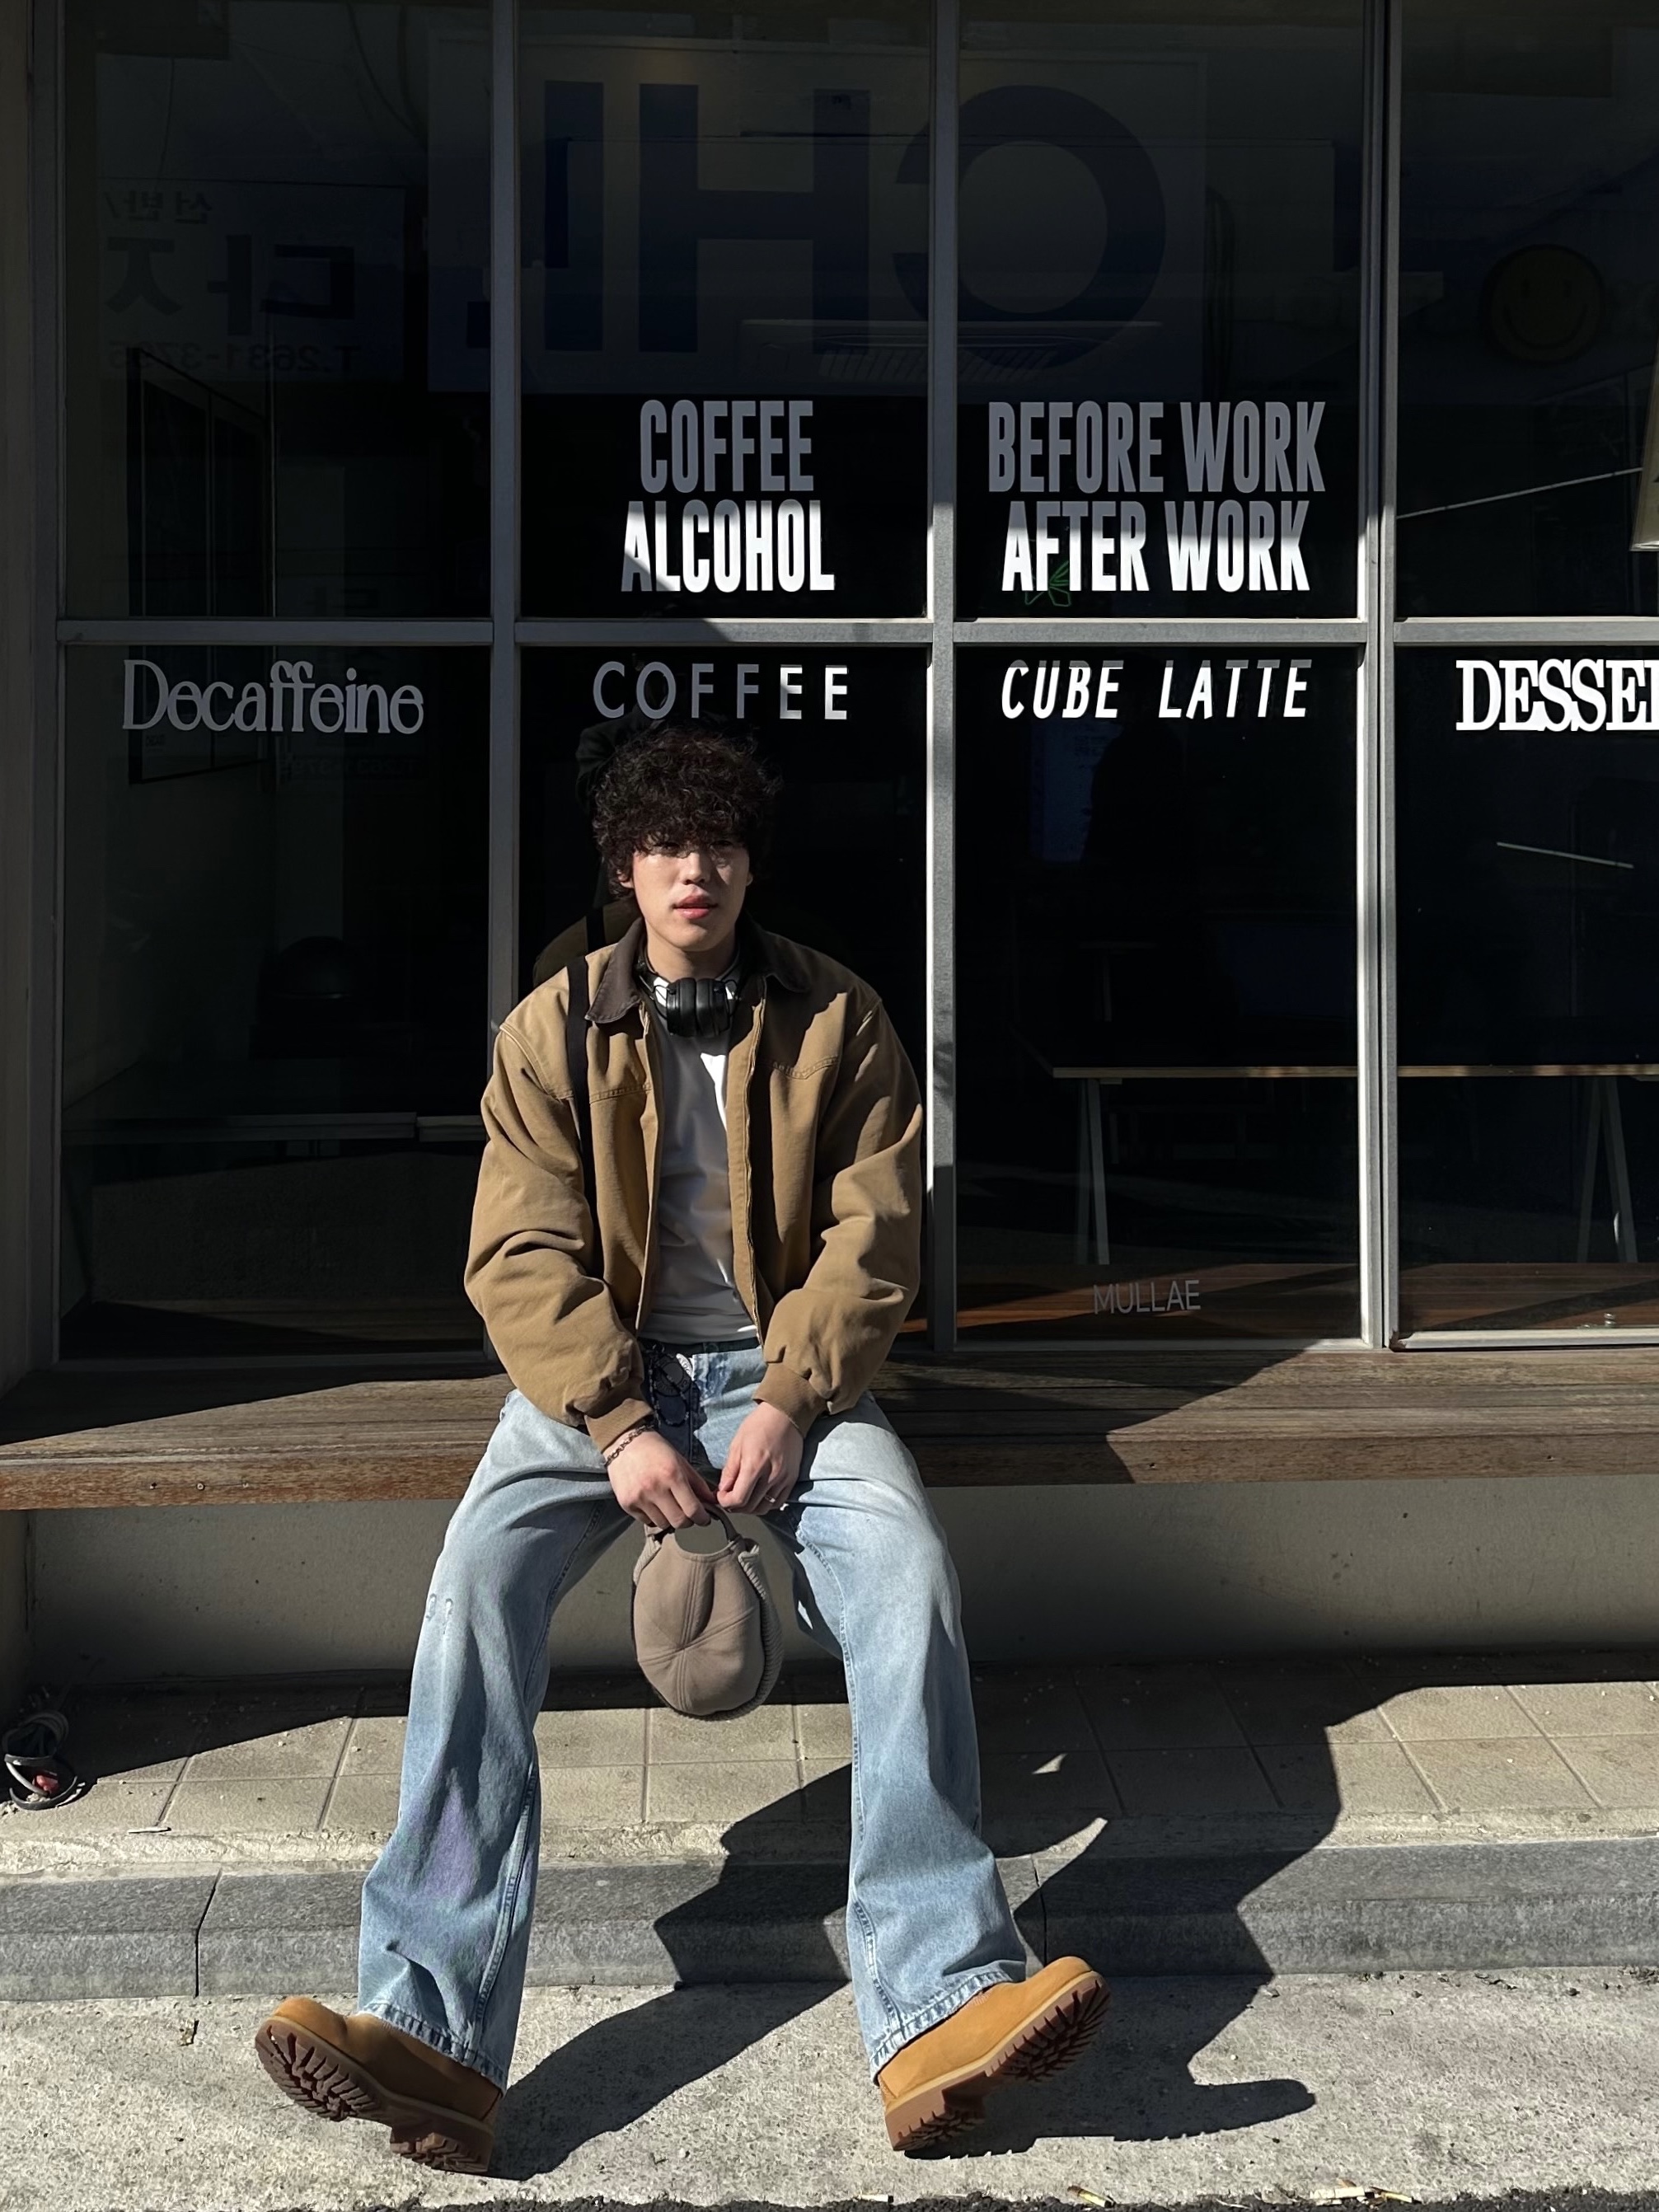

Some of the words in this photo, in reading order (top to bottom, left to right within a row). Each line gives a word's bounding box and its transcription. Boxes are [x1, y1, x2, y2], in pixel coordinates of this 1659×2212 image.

[640, 399, 814, 494] COFFEE
[988, 401, 1164, 494] BEFORE
[1180, 401, 1326, 494] WORK
[621, 499, 836, 593] ALCOHOL
[1001, 501, 1150, 593] AFTER
[1164, 500, 1310, 593] WORK
[123, 659, 424, 735] Decaffeine
[593, 661, 848, 720] COFFEE
[1001, 660, 1124, 719] CUBE
[1159, 660, 1312, 719] LATTE
[1094, 1279, 1202, 1315] MULLAE
